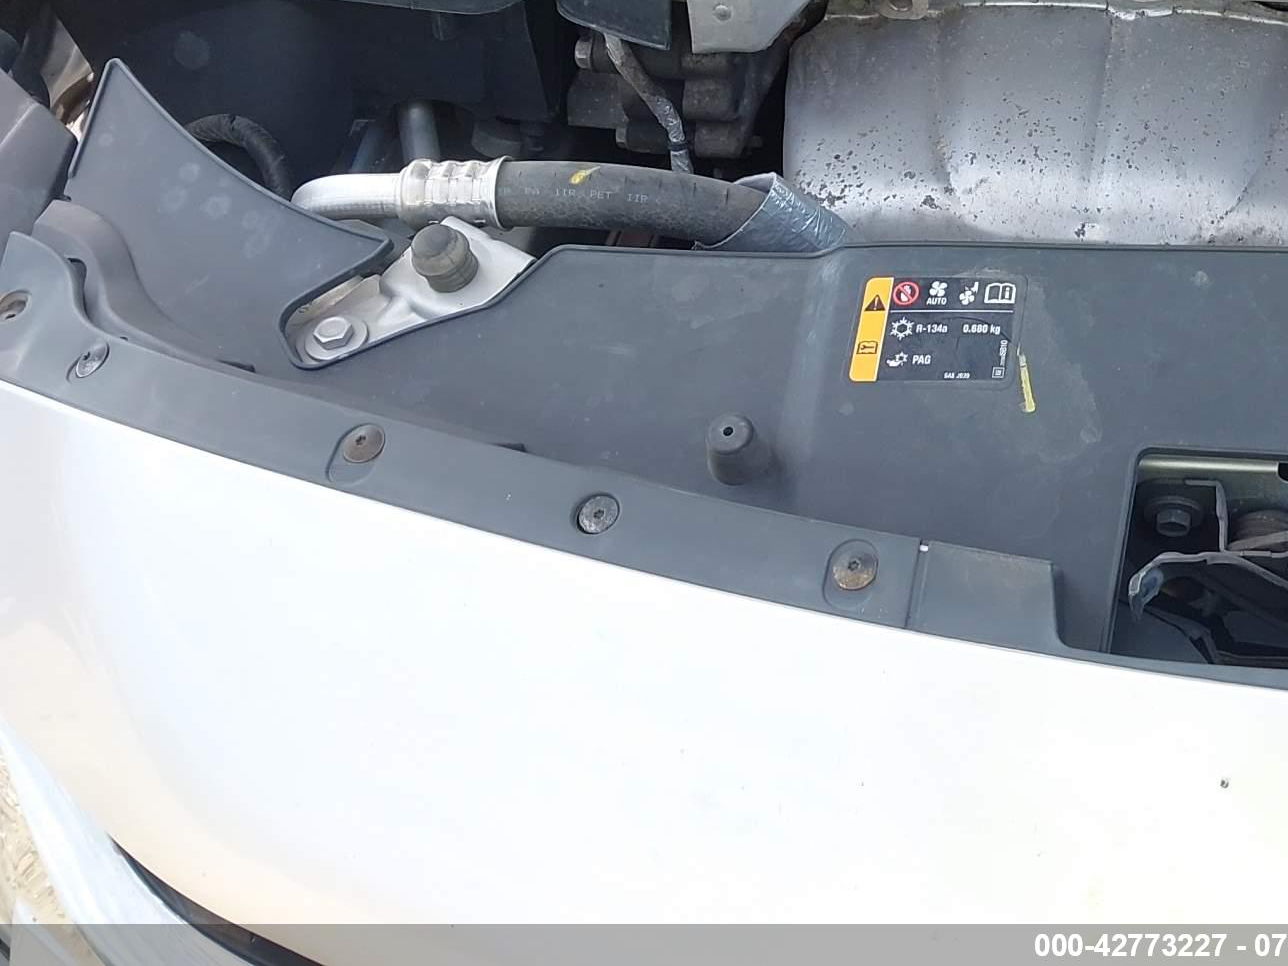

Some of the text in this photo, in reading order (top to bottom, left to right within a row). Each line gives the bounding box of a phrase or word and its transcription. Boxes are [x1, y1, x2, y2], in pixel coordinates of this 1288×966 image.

[590, 189, 612, 200] PET
[916, 324, 948, 333] R-134a
[990, 324, 1000, 334] kg
[912, 354, 932, 364] PAG
